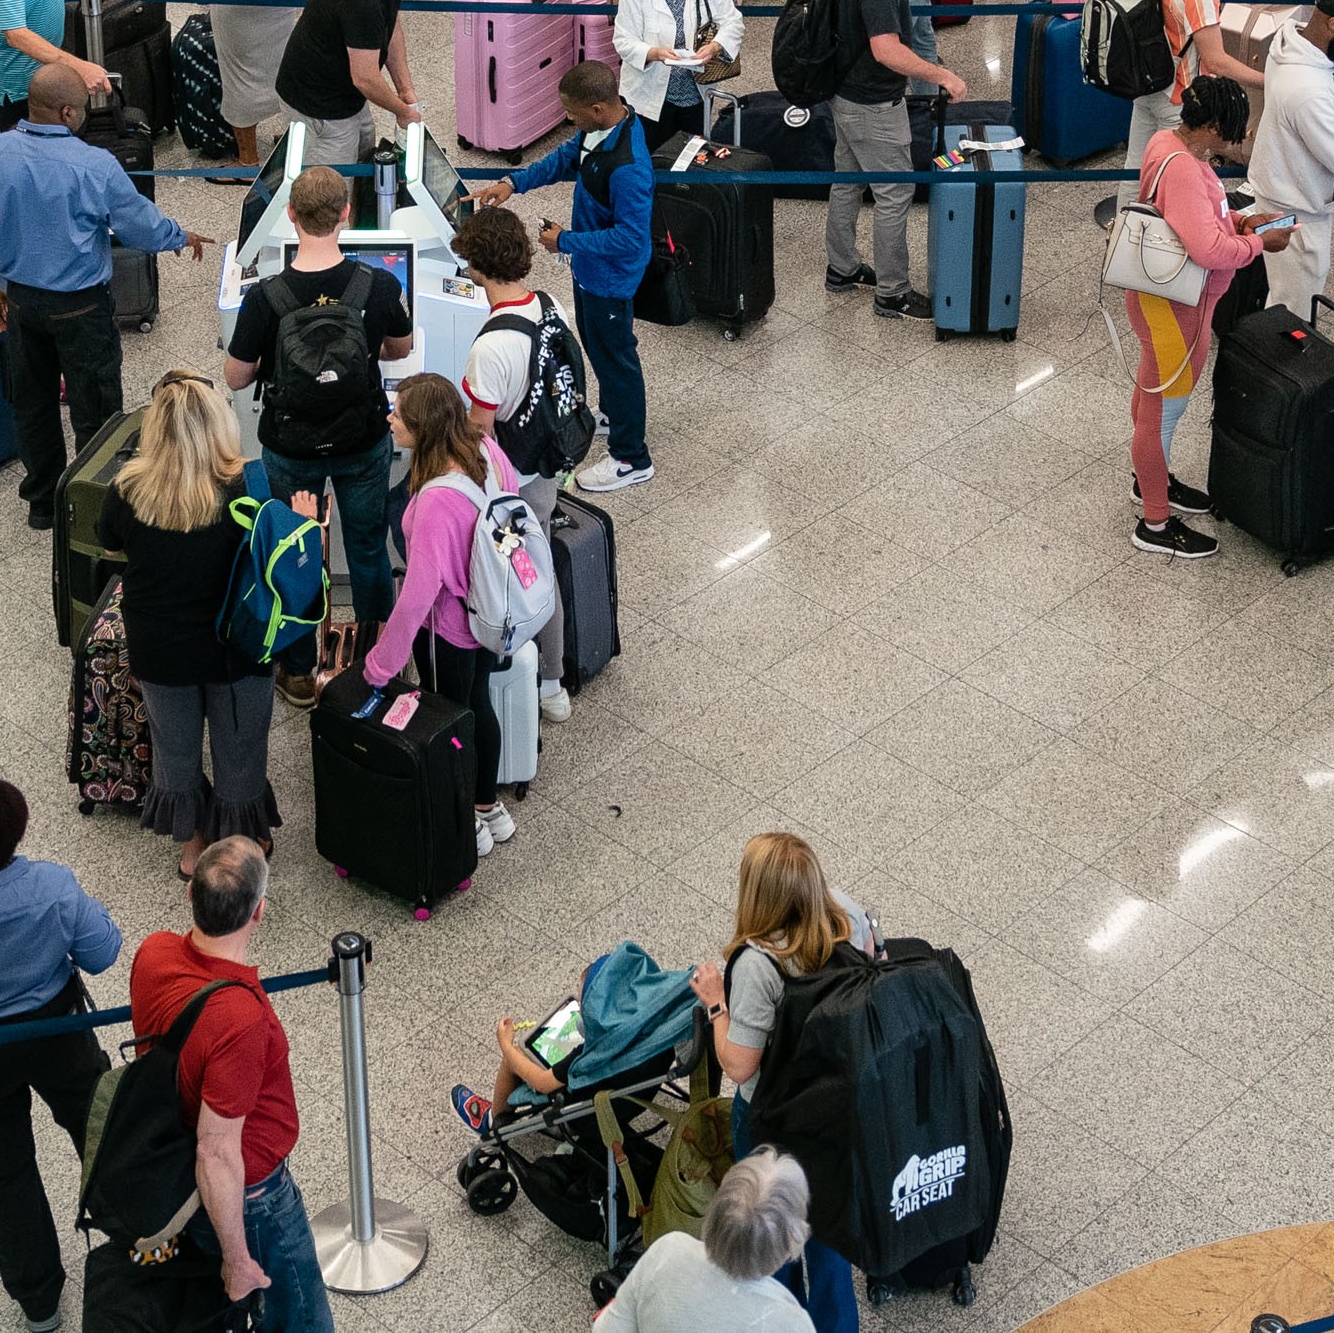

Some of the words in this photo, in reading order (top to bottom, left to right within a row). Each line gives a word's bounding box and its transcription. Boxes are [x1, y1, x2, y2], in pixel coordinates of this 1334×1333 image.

[918, 1156, 966, 1187] GRIP
[919, 1144, 966, 1169] GORILLA
[896, 1194, 920, 1222] CAR
[922, 1178, 956, 1207] SEAT
